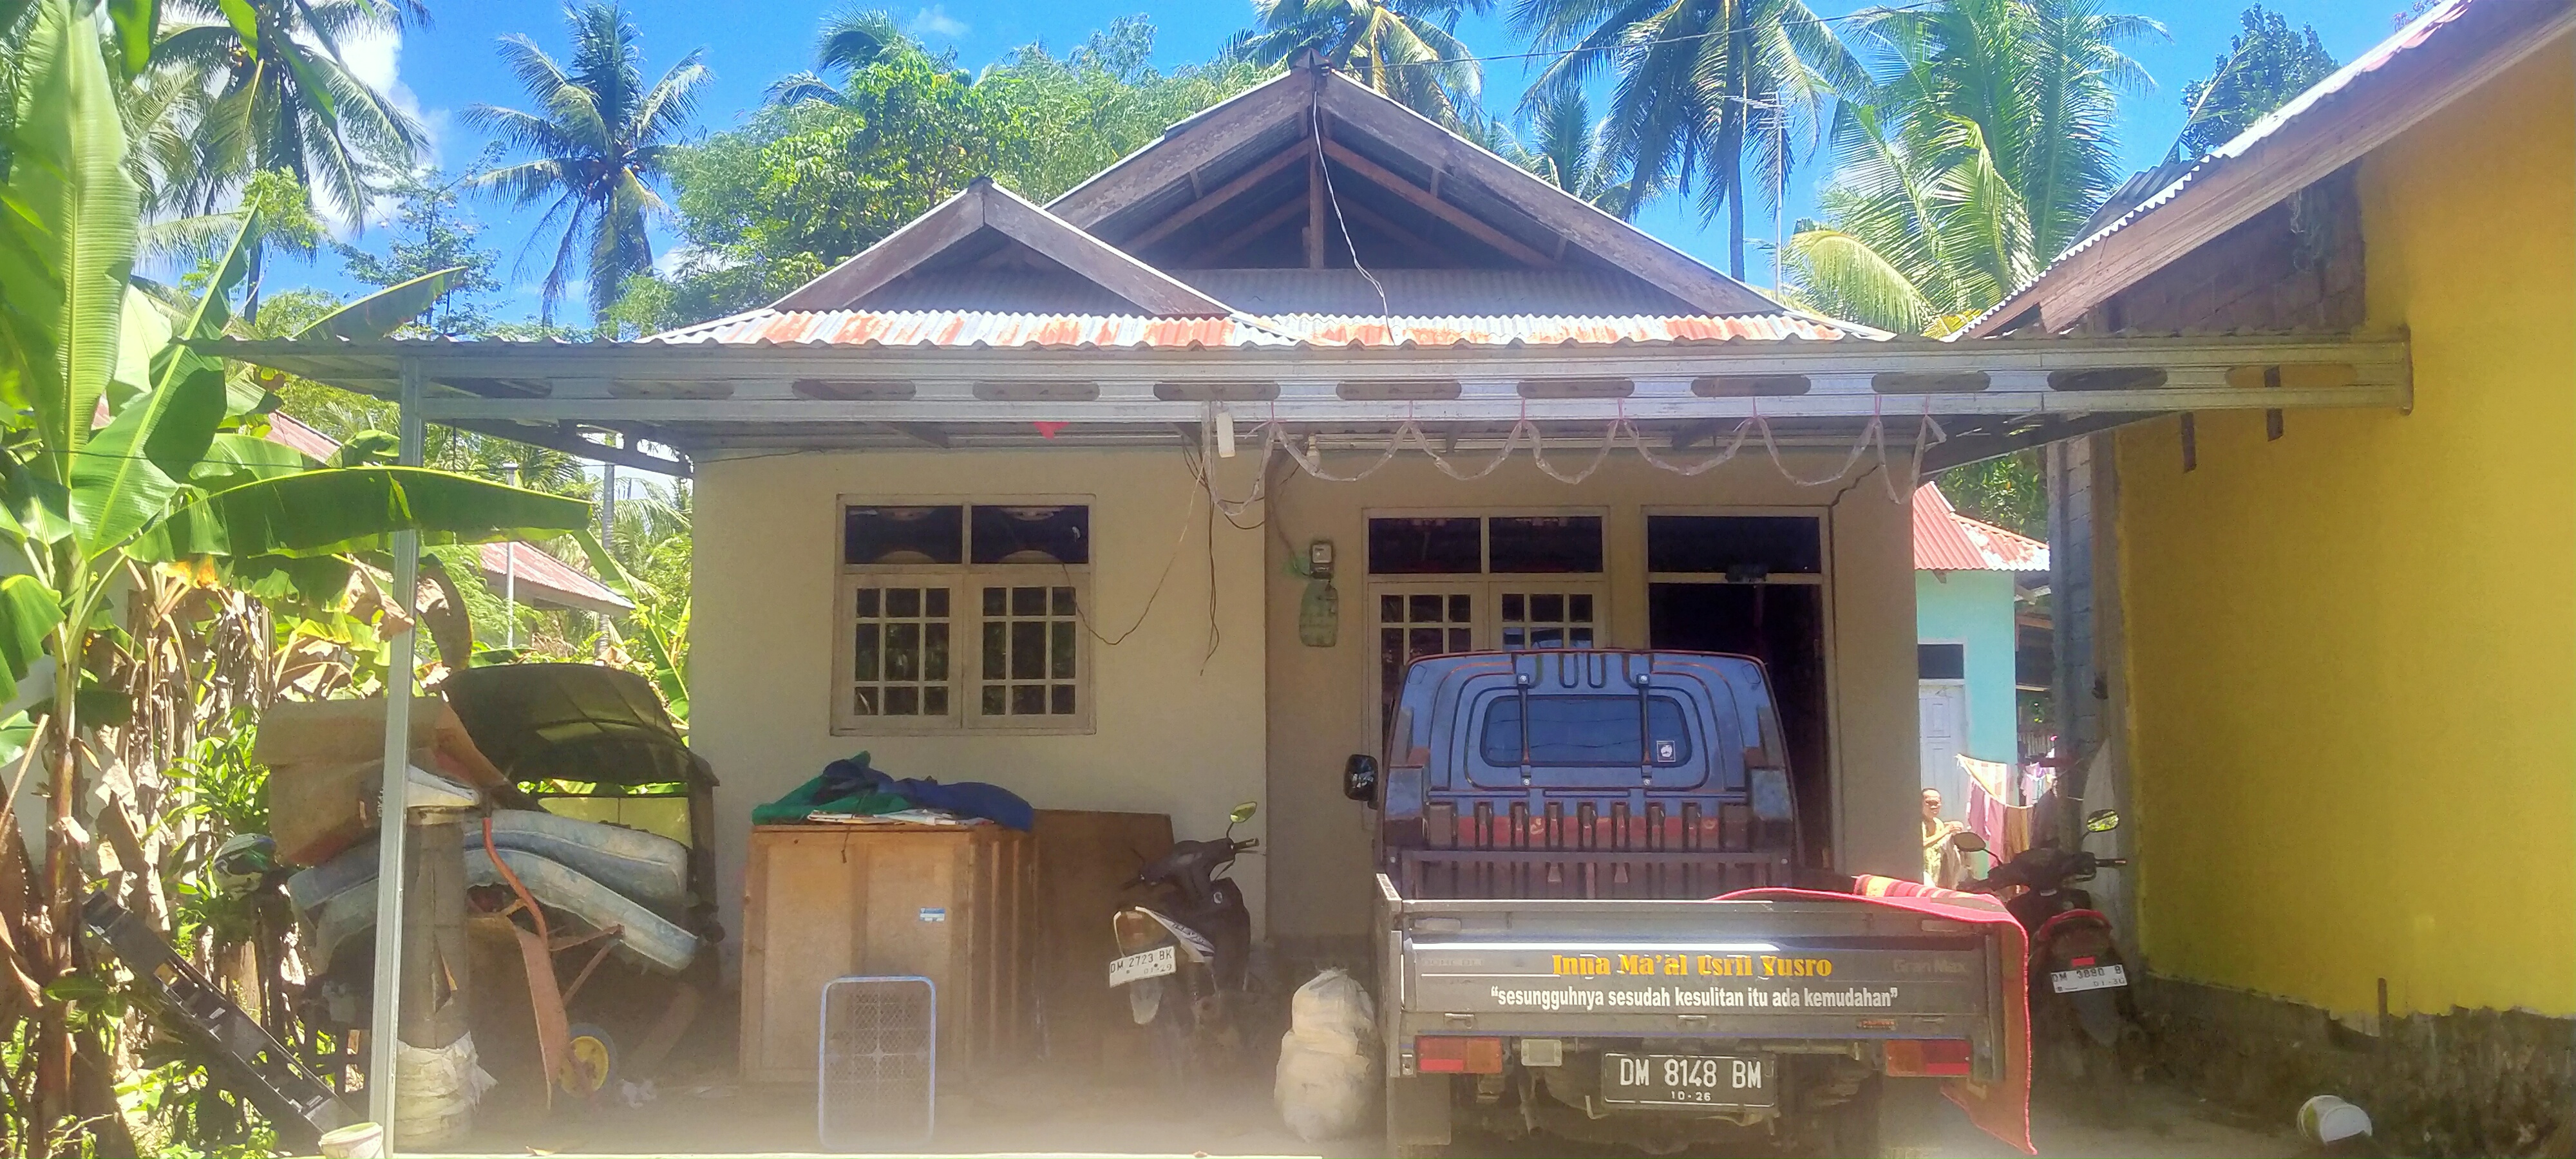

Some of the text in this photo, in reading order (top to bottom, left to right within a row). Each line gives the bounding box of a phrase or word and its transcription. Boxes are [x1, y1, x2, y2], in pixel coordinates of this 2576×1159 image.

[1110, 948, 1172, 974] DM 2723 BK
[1553, 954, 1611, 975] Inna
[1760, 955, 1833, 976] Yusro
[2052, 972, 2068, 982] DM
[1491, 986, 1898, 1012] “sesungguhnya sesudah kesulitan itu ada kemudahan”
[1620, 1058, 1762, 1089] DM 8148 BM
